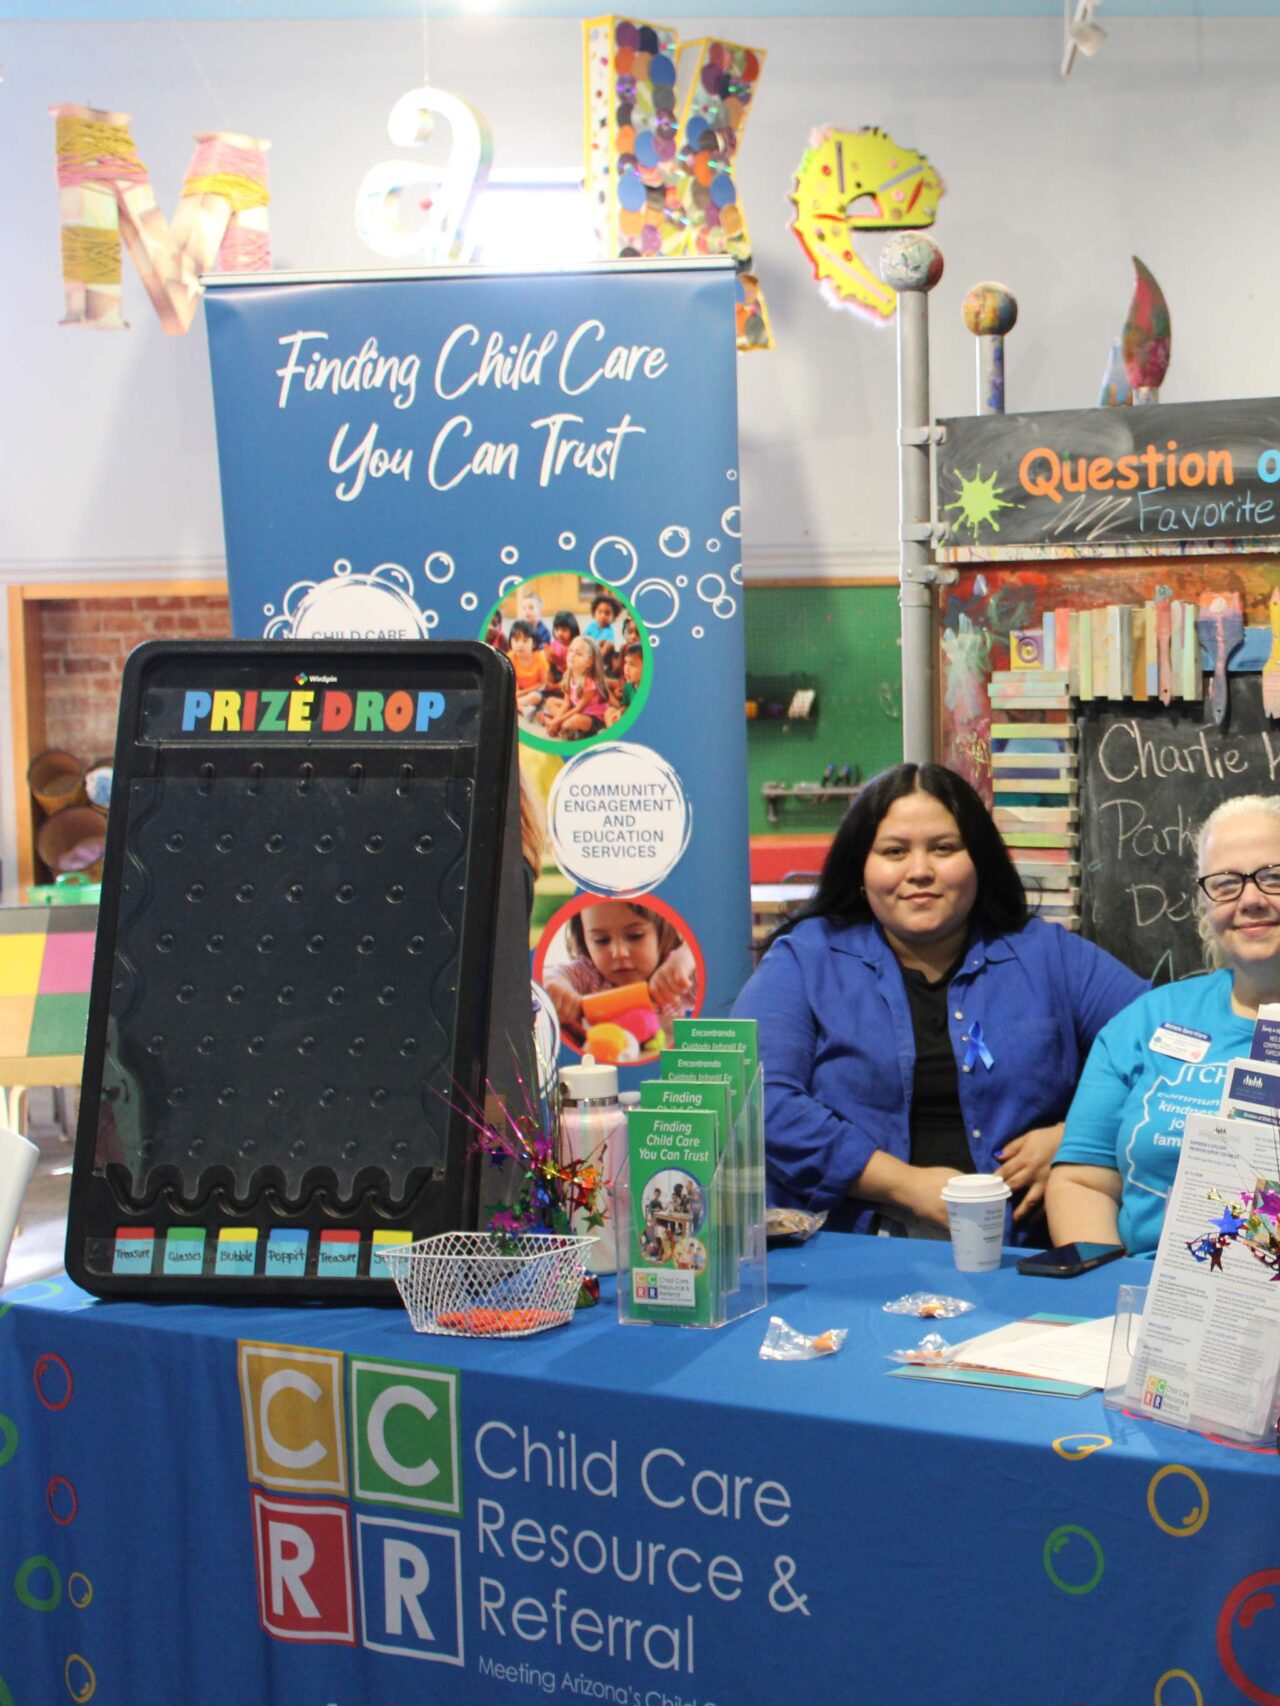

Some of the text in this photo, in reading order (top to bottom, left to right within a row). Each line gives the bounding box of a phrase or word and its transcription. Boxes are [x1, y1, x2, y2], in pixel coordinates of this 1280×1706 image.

[276, 319, 670, 409] Finding Child Care
[328, 412, 647, 502] You Can Trust
[1018, 441, 1234, 503] Question
[1137, 486, 1275, 534] Favorite
[312, 629, 407, 639] CHILD CARE
[181, 690, 446, 732] PRIZE DROP
[1099, 719, 1250, 784] Charlie
[569, 784, 668, 798] COMMUNITY
[564, 800, 674, 812] ENGAGEMENT
[602, 815, 637, 827] AND
[572, 830, 665, 843] EDUCATION
[582, 845, 657, 858] SERVICES
[663, 1091, 703, 1105] Finding
[653, 1120, 692, 1135] Finding
[646, 1134, 701, 1147] Child Care
[638, 1148, 709, 1162] You Can Trust
[115, 1249, 150, 1260] Treasure
[220, 1250, 254, 1263] Bubble
[320, 1252, 357, 1264] Treasure
[474, 1419, 792, 1528] Child Care
[477, 1497, 811, 1617] Resource &
[479, 1575, 695, 1674] Referral
[479, 1656, 556, 1694] Meeting
[560, 1671, 641, 1706] Arizona's
